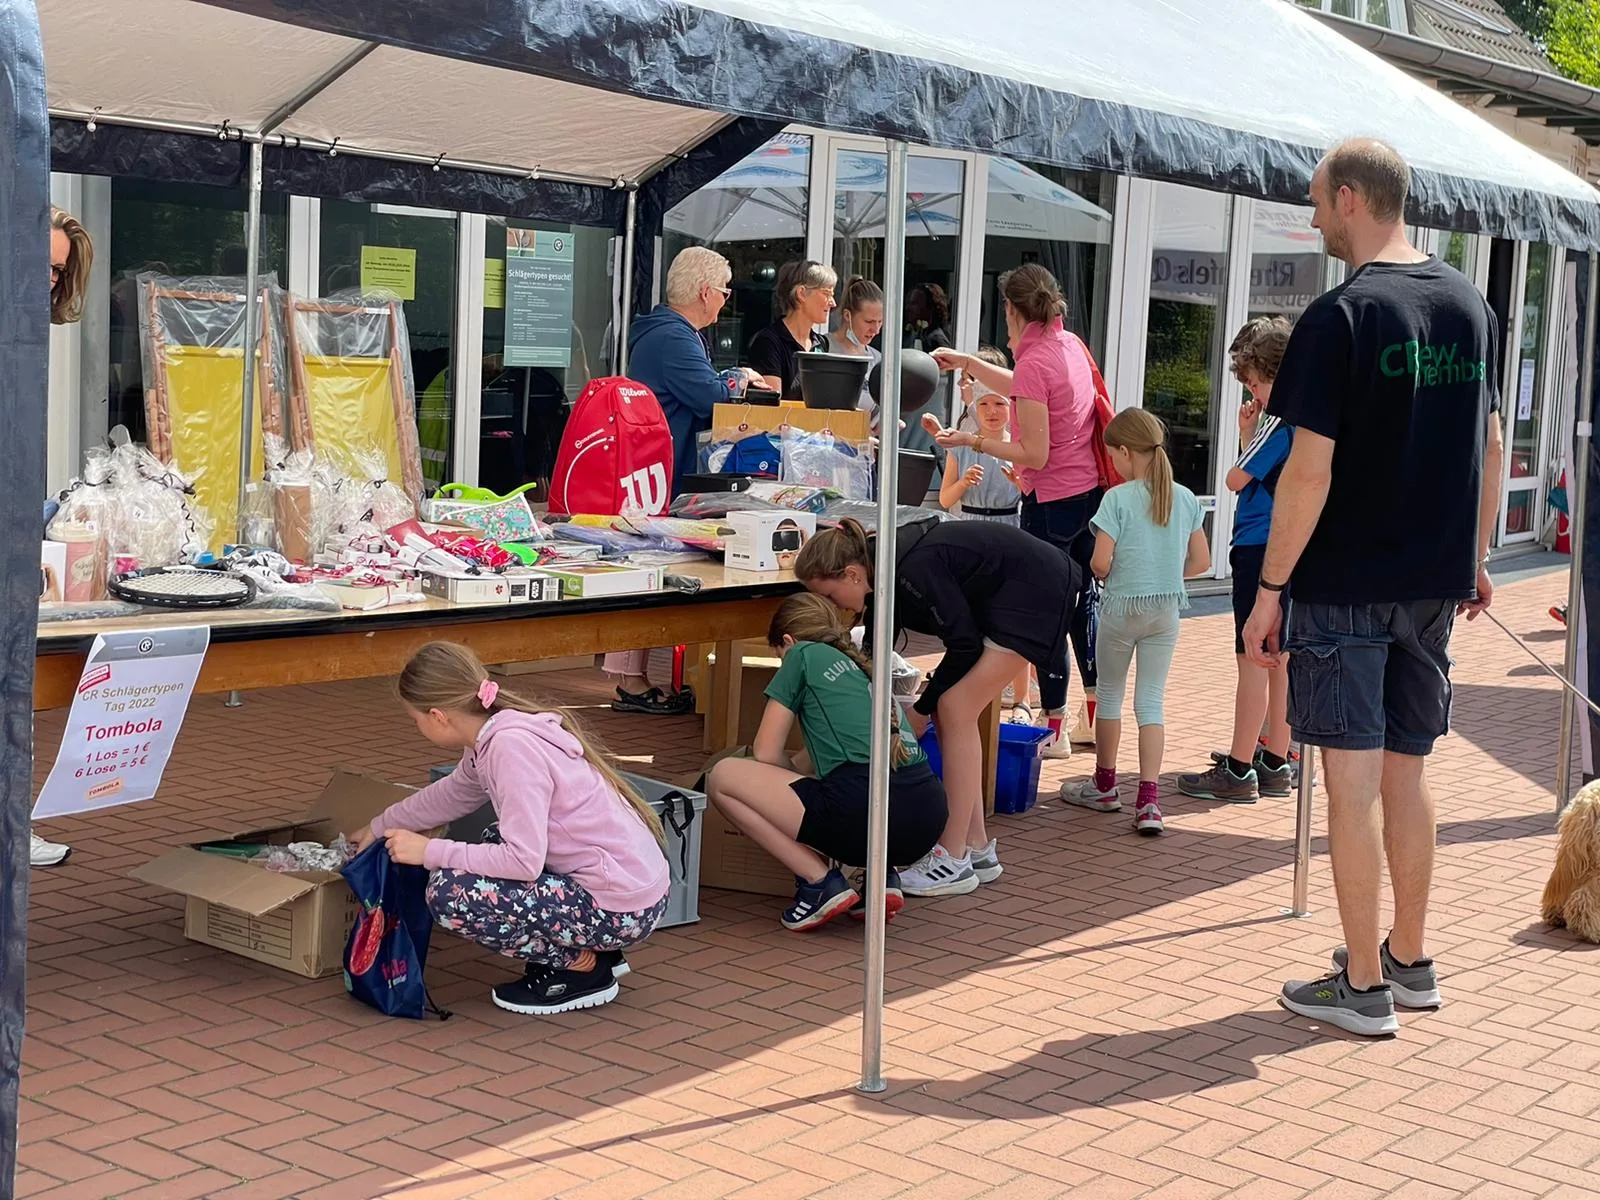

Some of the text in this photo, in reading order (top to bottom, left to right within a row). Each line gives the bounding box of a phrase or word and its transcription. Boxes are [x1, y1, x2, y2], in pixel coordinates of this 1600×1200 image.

[508, 268, 548, 281] Schlägertypen
[548, 273, 572, 282] gesucht!
[618, 387, 648, 397] Wilson
[82, 690, 98, 702] CR
[101, 682, 184, 699] Schlägertypen
[105, 697, 156, 713] Tag 2022
[85, 718, 163, 742] Tombola
[86, 753, 92, 764] 1
[95, 750, 118, 763] Los
[134, 744, 140, 754] 1
[142, 741, 151, 752] €
[75, 768, 83, 778] 6
[86, 763, 117, 777] Lose
[130, 757, 137, 768] 5
[139, 755, 148, 765] €
